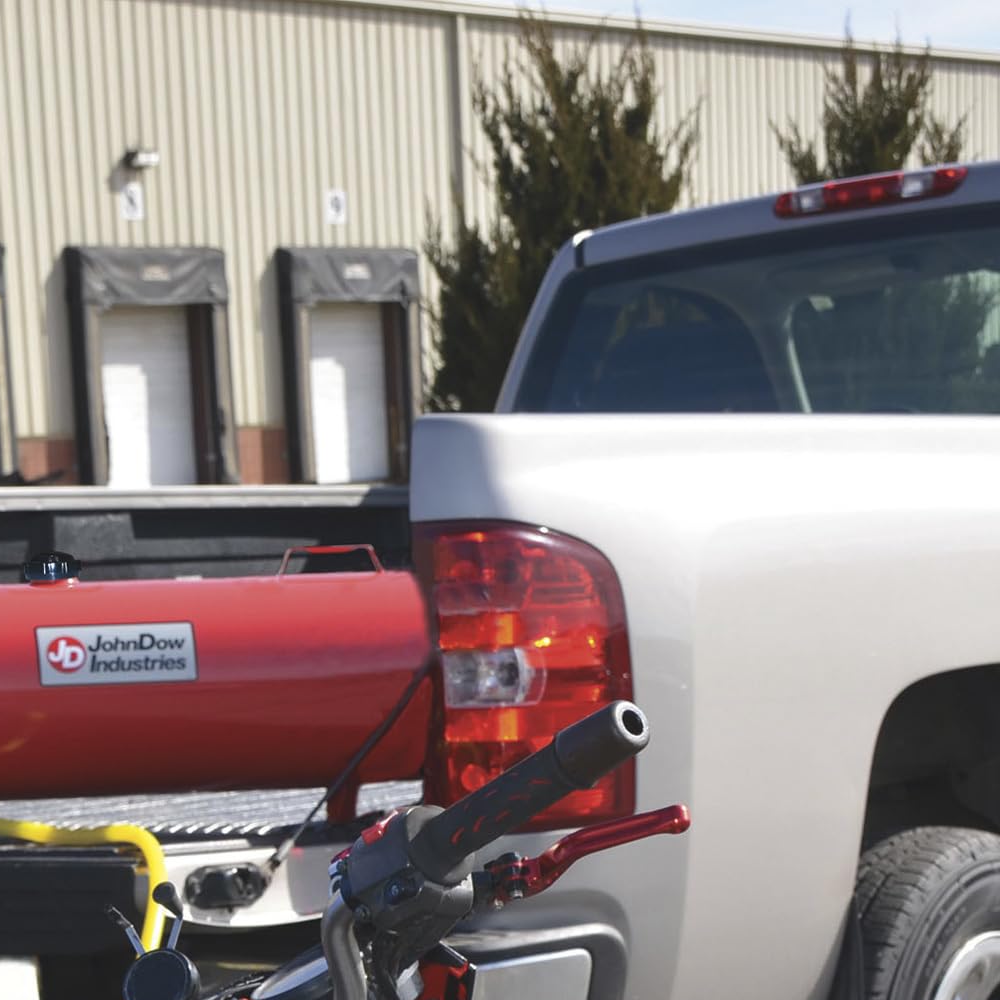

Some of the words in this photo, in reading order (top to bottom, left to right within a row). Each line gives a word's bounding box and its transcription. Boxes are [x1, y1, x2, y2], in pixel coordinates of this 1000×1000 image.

[88, 633, 185, 653] JohnDow
[48, 638, 85, 669] JD
[90, 654, 187, 674] Industries
